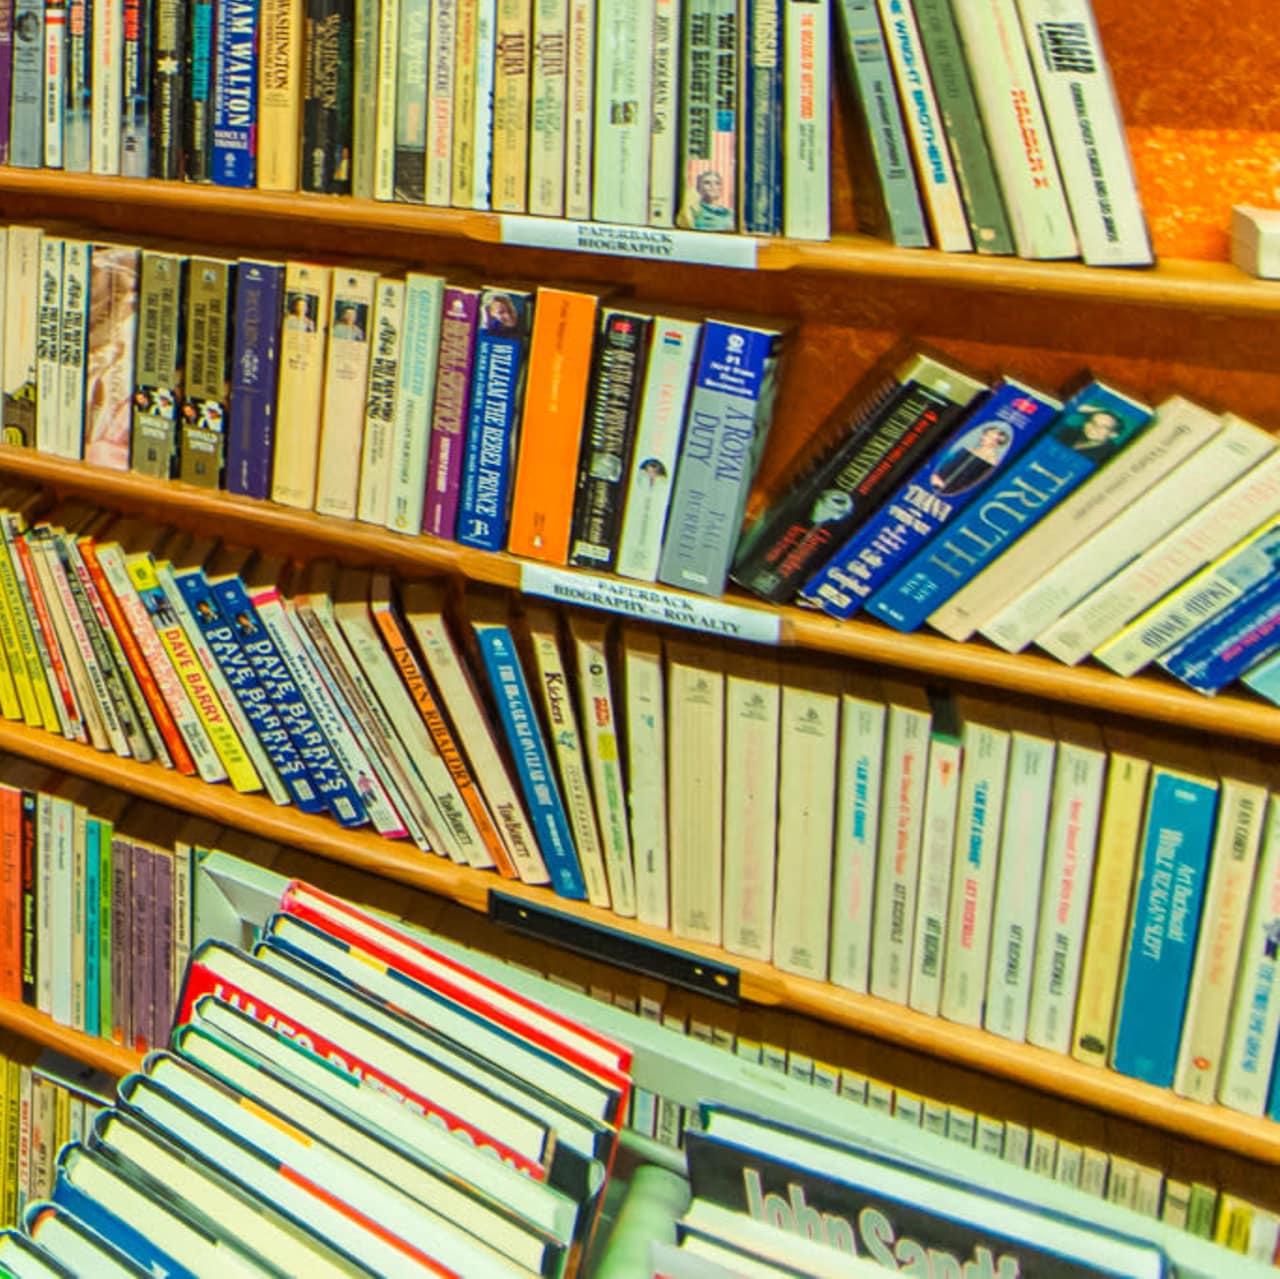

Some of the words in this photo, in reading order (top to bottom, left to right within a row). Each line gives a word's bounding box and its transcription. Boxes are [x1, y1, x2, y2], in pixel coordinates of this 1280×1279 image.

[690, 13, 710, 45] THE
[716, 13, 734, 48] TOM
[1043, 21, 1096, 74] YEAGER
[229, 41, 251, 127] WALTON
[690, 48, 710, 105] RIGHT
[716, 51, 734, 111] WOLFE
[893, 19, 921, 85] WRIGHT
[913, 89, 946, 185] BROTHERS
[689, 107, 710, 159] STUFF
[577, 225, 673, 244] PAPERBACK
[577, 237, 672, 256] BIOGRAPHY
[484, 343, 512, 400] WILLIAM
[482, 402, 505, 429] THE
[685, 412, 718, 466] DUTY
[729, 406, 754, 423] A
[478, 431, 503, 471] REBEL
[714, 427, 752, 482] ROYAL
[474, 473, 498, 518] PRINCE
[929, 460, 1074, 581] TRUTH
[552, 584, 646, 614] BIOGRAPHY
[663, 609, 741, 634] ROYALTY
[597, 580, 694, 611] PAPERBACK
[165, 628, 194, 668] DAVE
[177, 671, 224, 725] BARRY
[213, 626, 250, 680] DAVE
[258, 687, 306, 775] BARRY'S
[256, 638, 293, 696] DAVE
[280, 701, 347, 791] BARRY'S
[392, 646, 430, 704] INDIAN
[423, 709, 474, 792] RIBALDRY
[542, 672, 565, 725] Kickers
